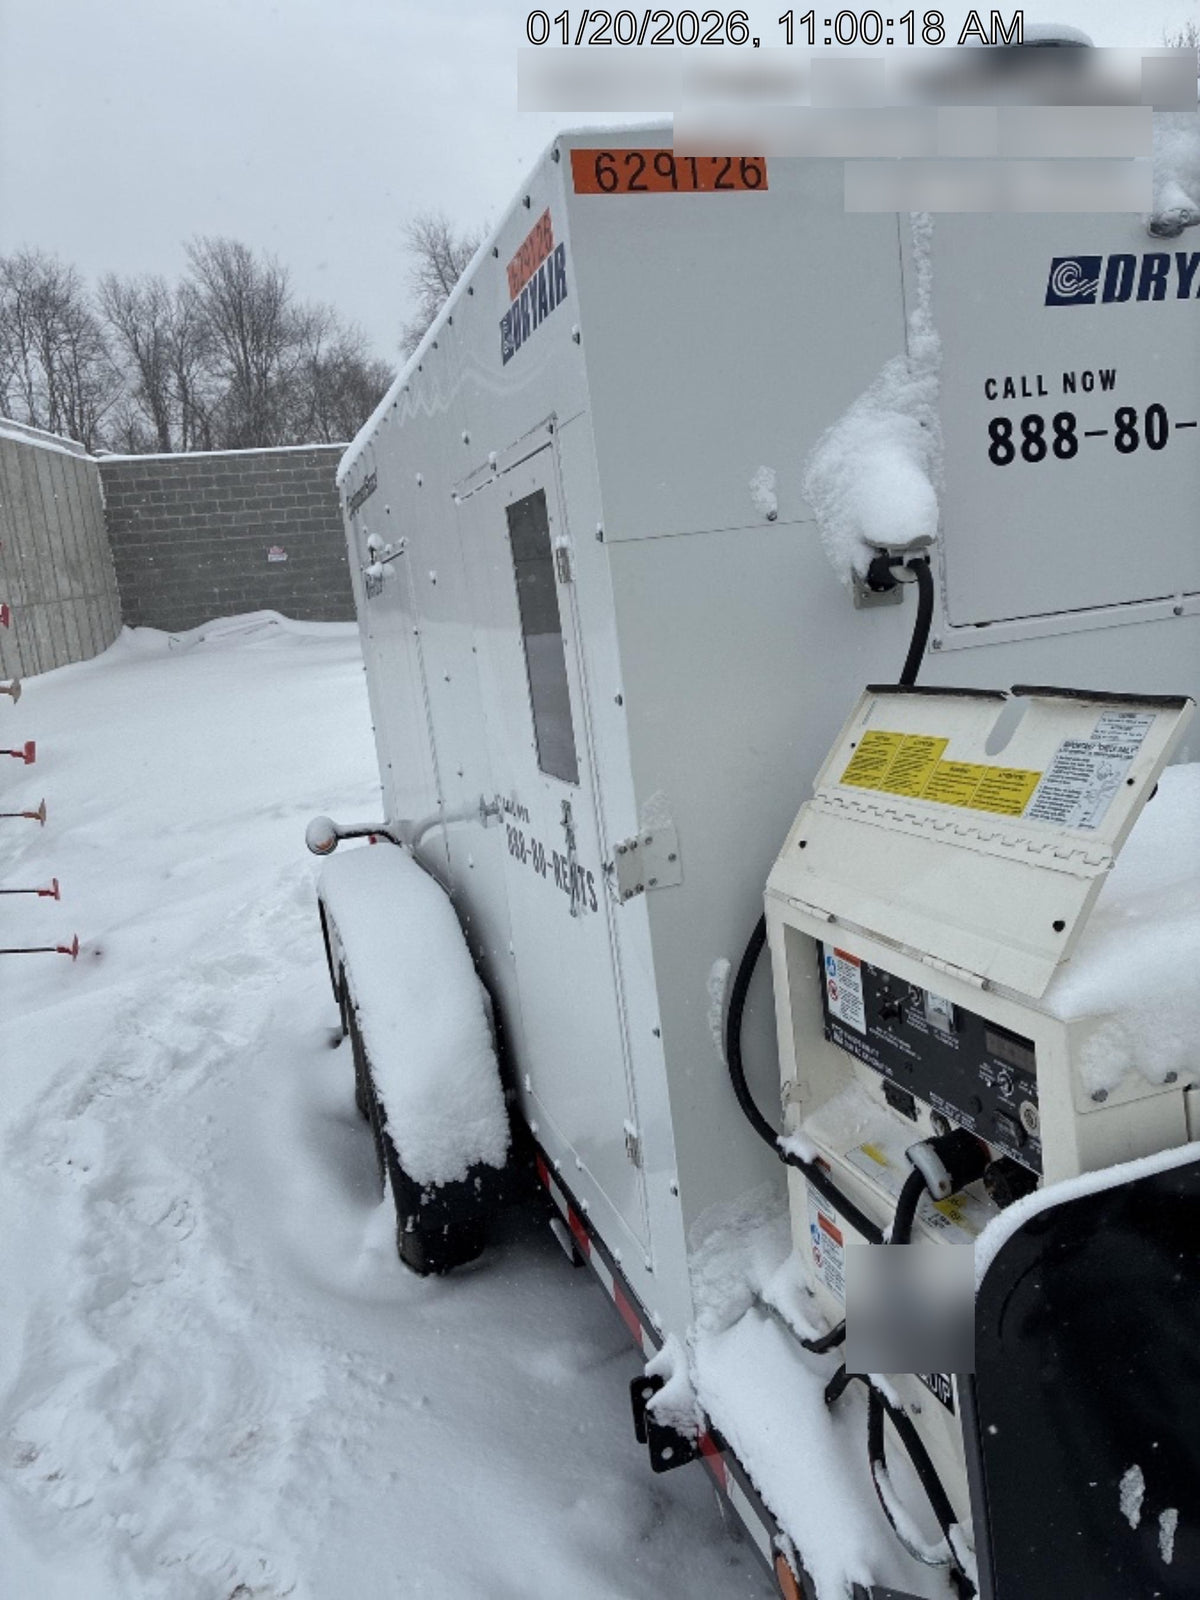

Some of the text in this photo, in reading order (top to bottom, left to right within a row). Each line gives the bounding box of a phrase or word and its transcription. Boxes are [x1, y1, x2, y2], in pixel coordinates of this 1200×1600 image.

[594, 151, 762, 193] 629126
[511, 241, 568, 352] DRYAIR
[1101, 252, 1200, 305] DRY
[984, 368, 1117, 401] CALL NOW
[988, 402, 1198, 467] 888-80-
